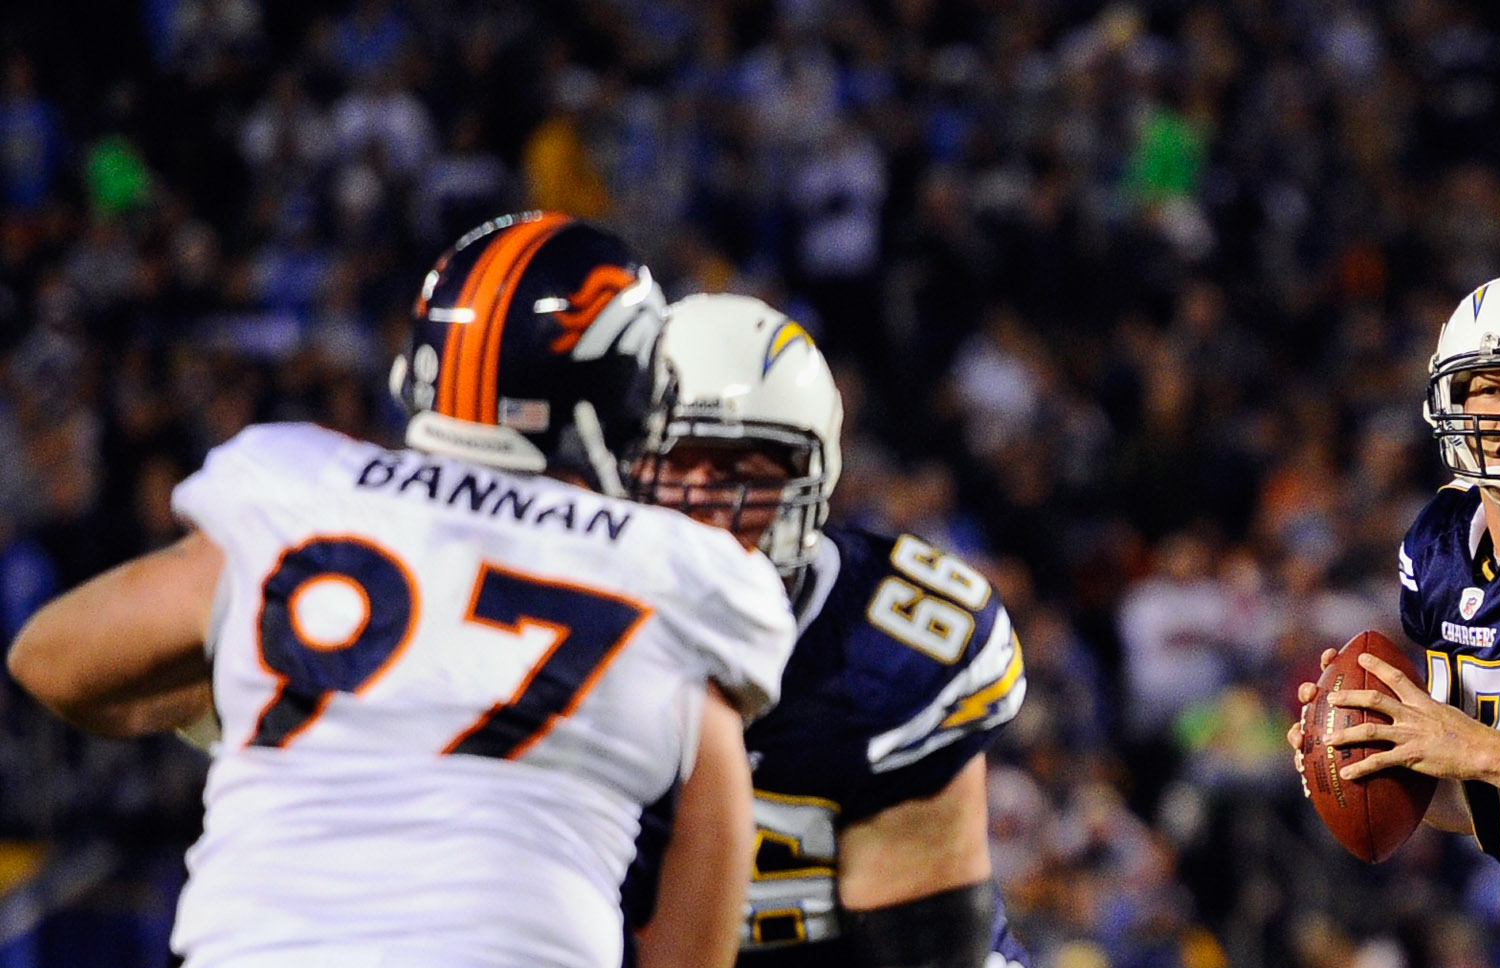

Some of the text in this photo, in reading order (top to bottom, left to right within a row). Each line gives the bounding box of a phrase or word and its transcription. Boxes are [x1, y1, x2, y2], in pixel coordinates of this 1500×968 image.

[357, 456, 630, 540] BANNAN
[866, 533, 993, 665] 66
[243, 534, 653, 762] 97
[1441, 620, 1497, 648] CHARGERS
[1326, 711, 1336, 759] FOBALL
[1329, 762, 1347, 809] NATIONAL
